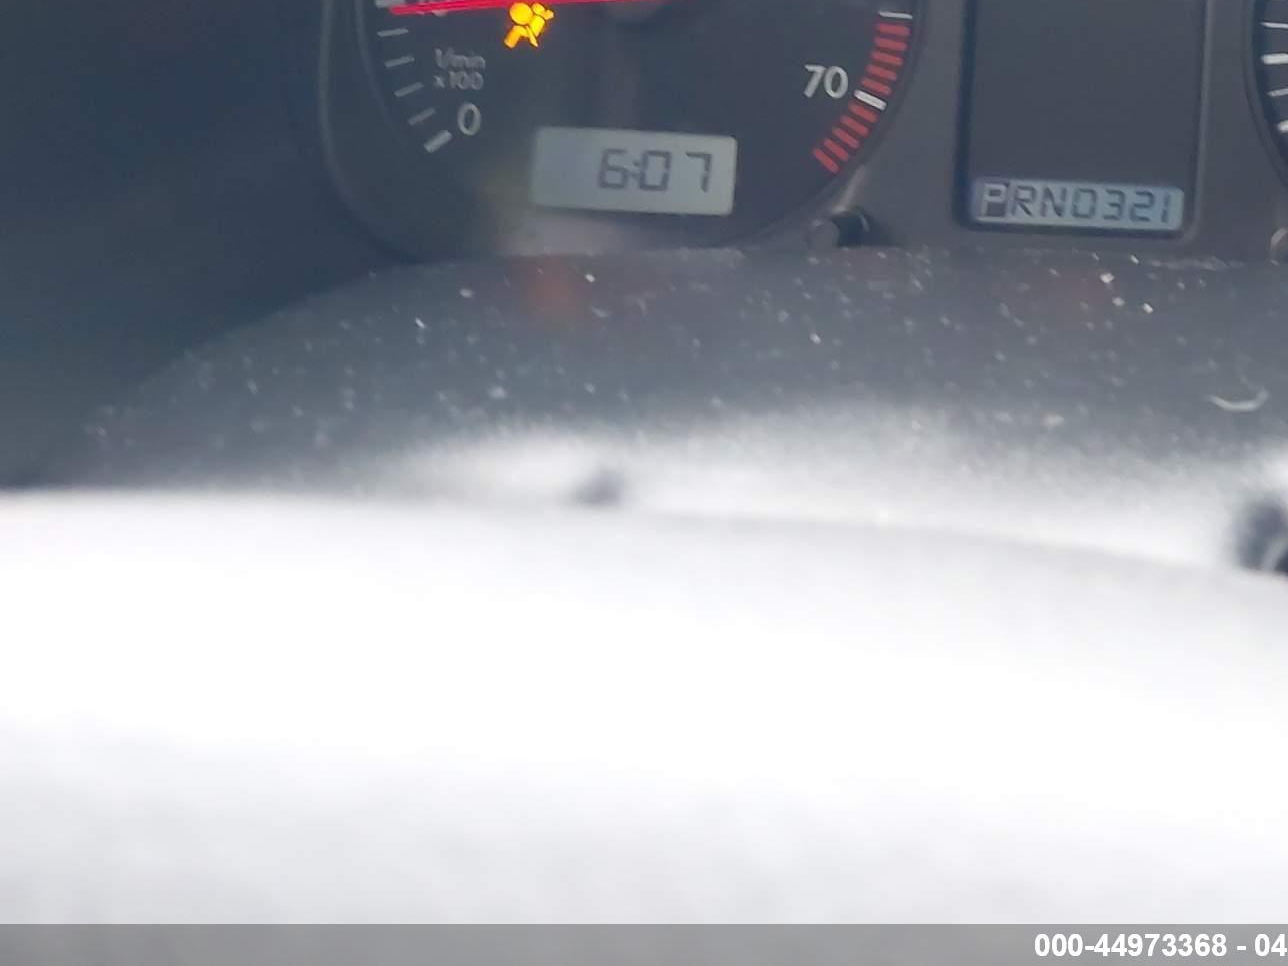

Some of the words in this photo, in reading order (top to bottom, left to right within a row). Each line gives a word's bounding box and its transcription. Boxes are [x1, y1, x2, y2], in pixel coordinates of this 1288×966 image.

[803, 65, 848, 97] 70
[457, 103, 481, 136] 0
[600, 148, 712, 191] 6:07
